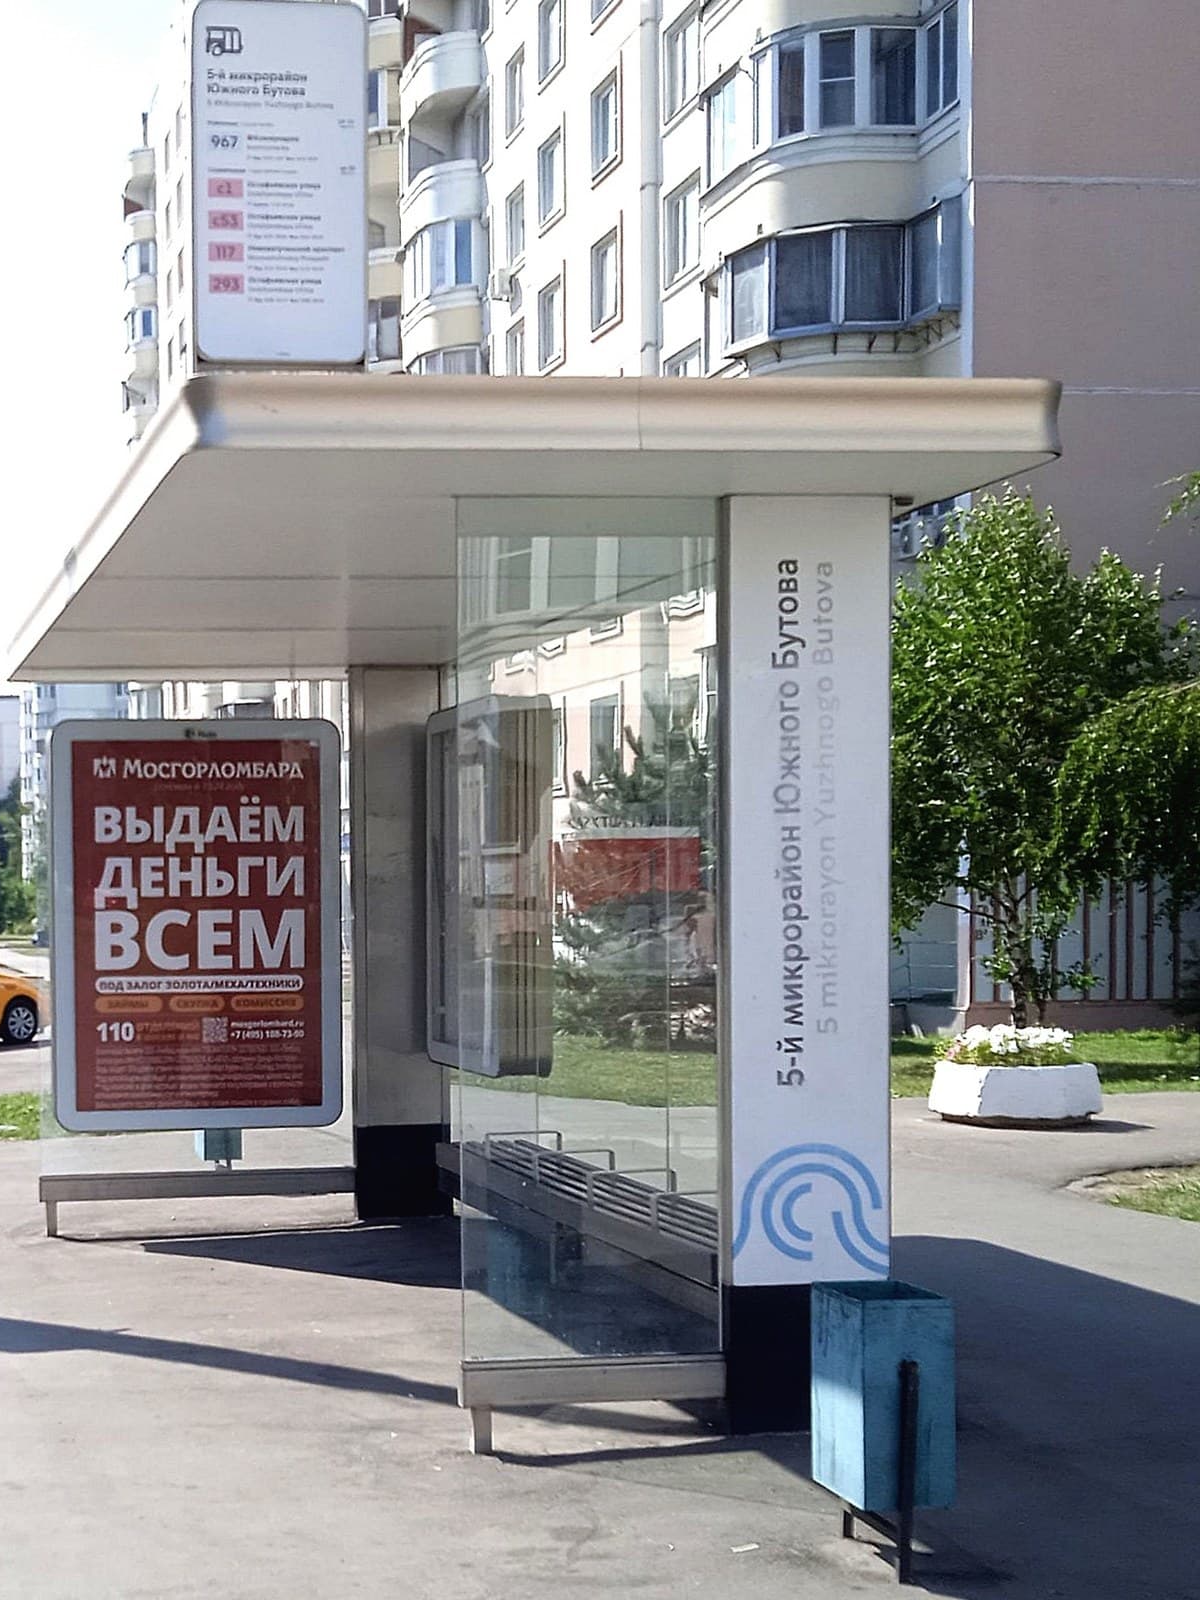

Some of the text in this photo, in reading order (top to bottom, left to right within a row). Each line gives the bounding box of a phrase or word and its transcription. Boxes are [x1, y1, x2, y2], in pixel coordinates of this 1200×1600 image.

[229, 70, 307, 83] микрорайон
[207, 82, 306, 97] Южного Бутова
[211, 134, 239, 149] 967
[213, 277, 240, 291] 293
[812, 562, 845, 1034] 5 mikrorayon Yuzhnogo Butova
[94, 795, 305, 854] ВЫДАЁМ
[771, 559, 810, 1087] 5-й микрорайон Южного Бутова
[93, 856, 305, 910] ДЕНЬГИ
[94, 908, 305, 972] ВСЕМ
[100, 980, 124, 992] ПОД
[127, 980, 163, 990] ЗАЛОГ
[96, 1021, 135, 1042] 110
